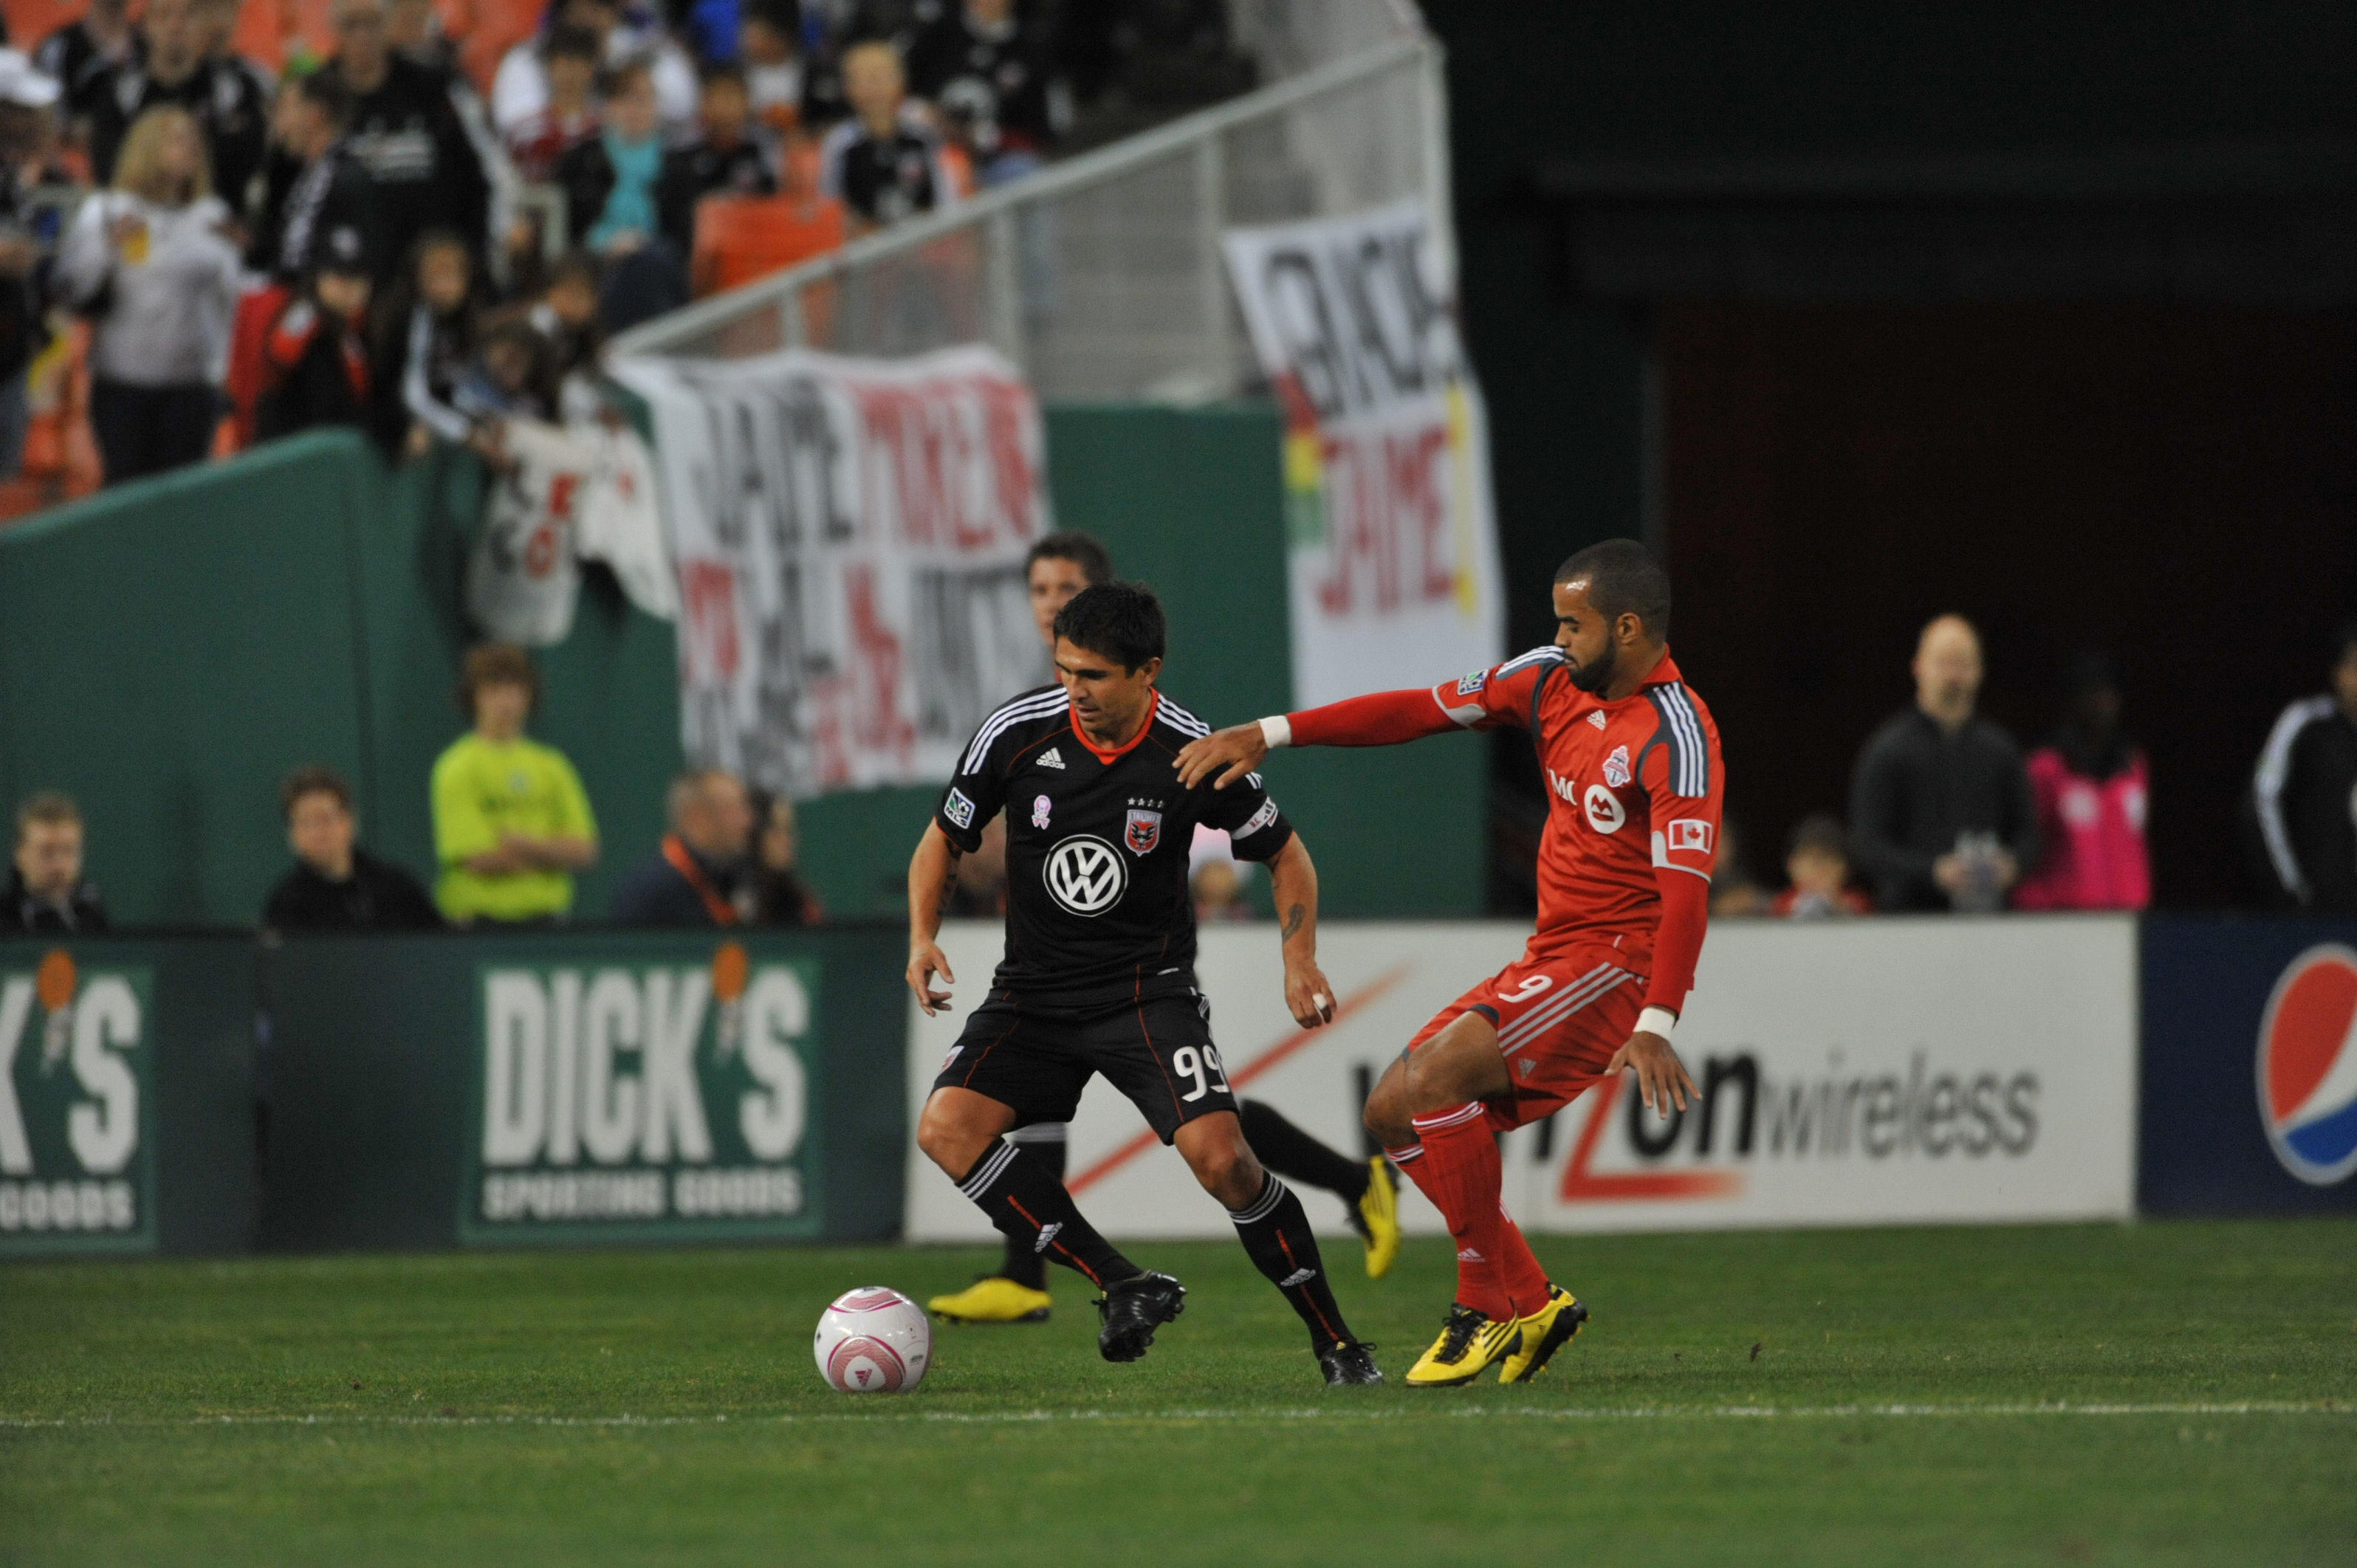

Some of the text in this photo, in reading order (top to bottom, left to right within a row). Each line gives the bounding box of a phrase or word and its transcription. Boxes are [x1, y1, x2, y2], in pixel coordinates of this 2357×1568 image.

[1036, 758, 1066, 769] adidas
[946, 807, 967, 827] MLS
[1498, 975, 1553, 1003] 9
[484, 949, 809, 1163] DICK'S
[1173, 1045, 1229, 1102] 99
[1760, 1047, 2042, 1159] wireless
